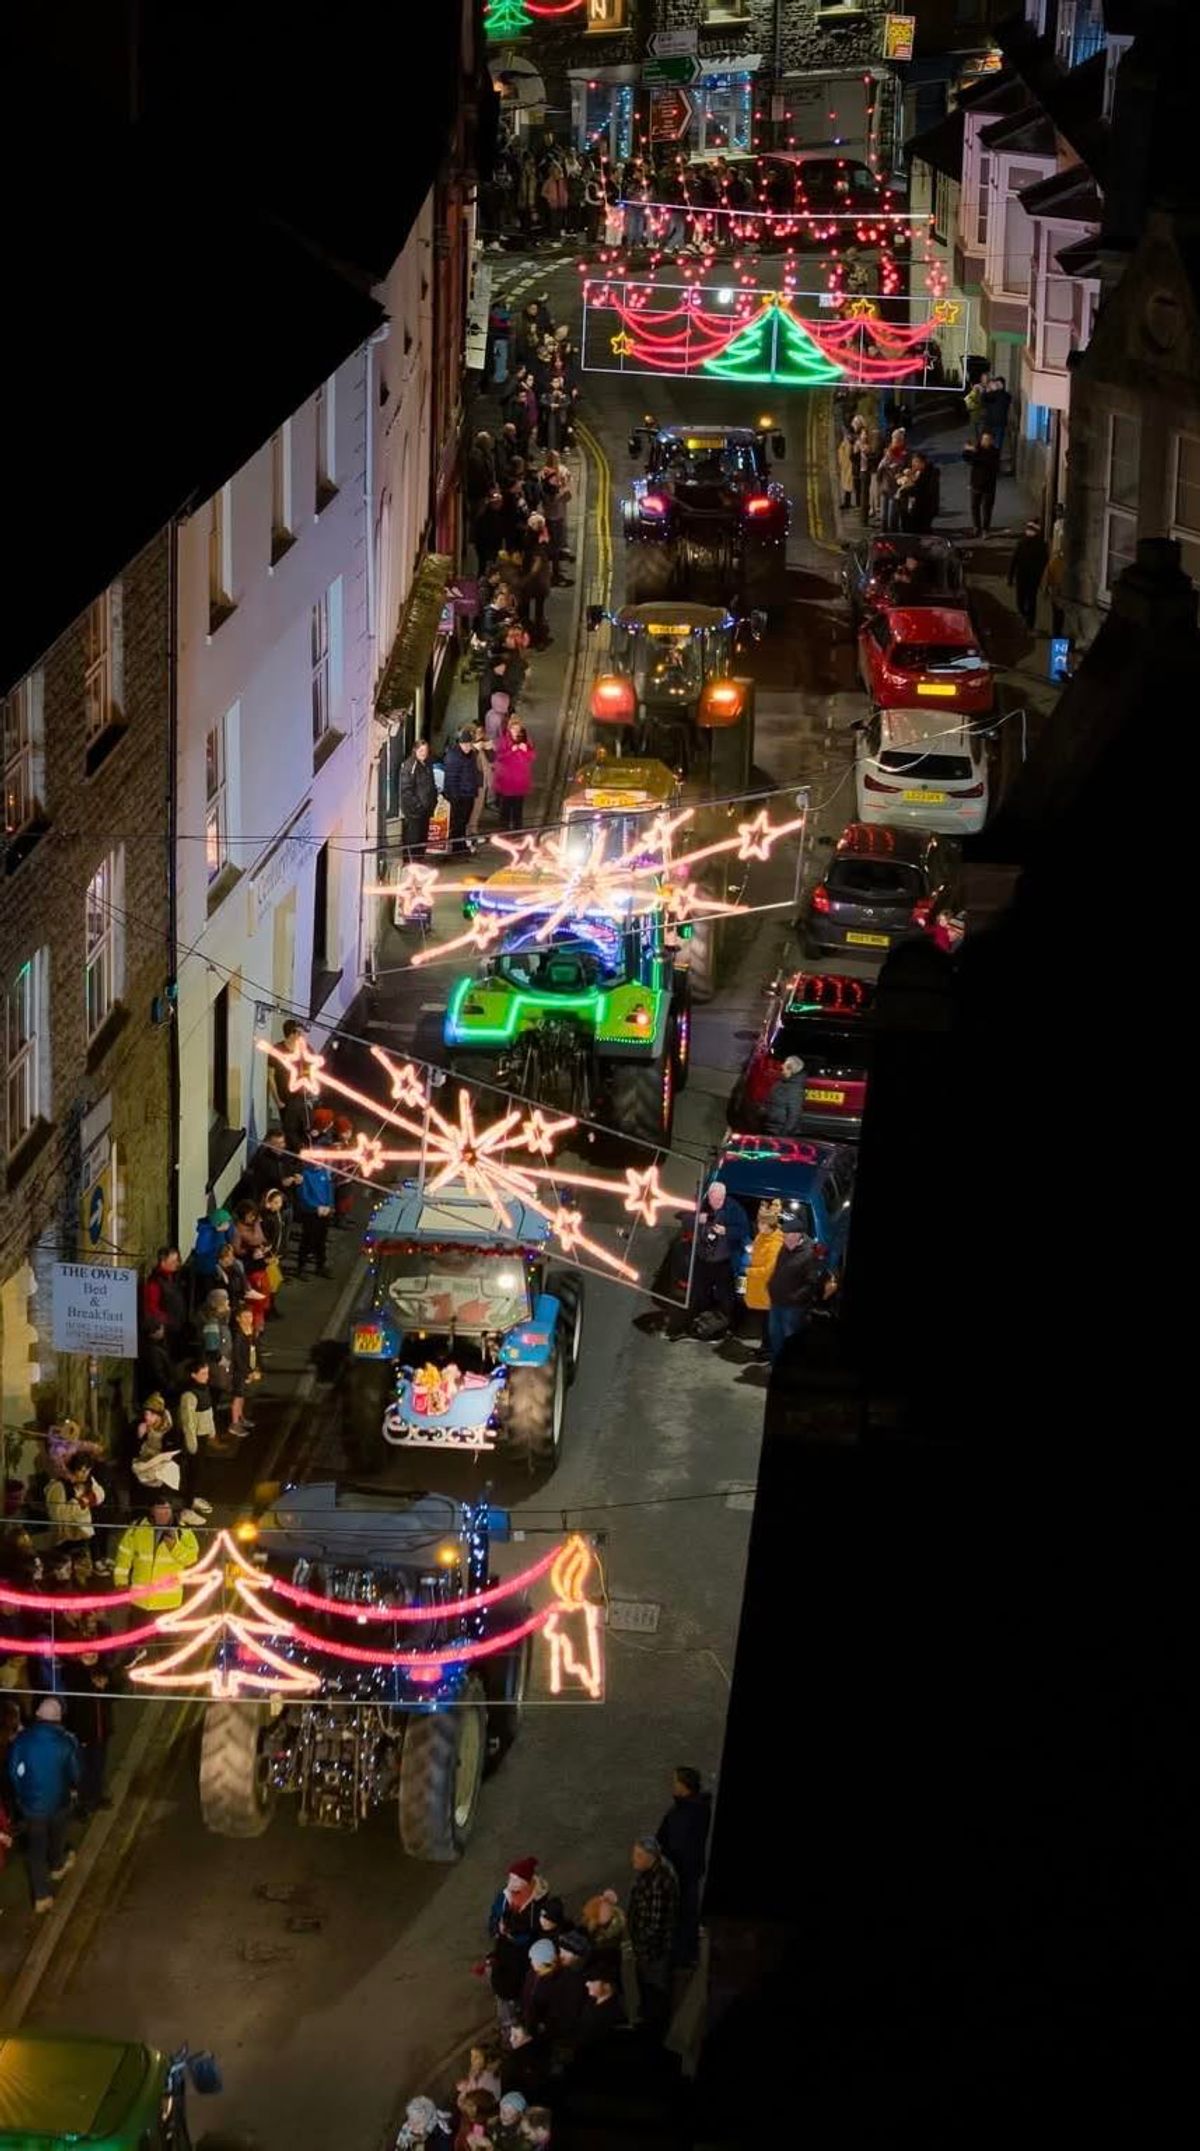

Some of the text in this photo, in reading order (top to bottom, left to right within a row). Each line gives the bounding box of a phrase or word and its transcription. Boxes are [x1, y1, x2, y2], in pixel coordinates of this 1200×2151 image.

[61, 1265, 130, 1281] THE OWLS
[83, 1282, 108, 1295] Bed
[89, 1296, 100, 1307] &
